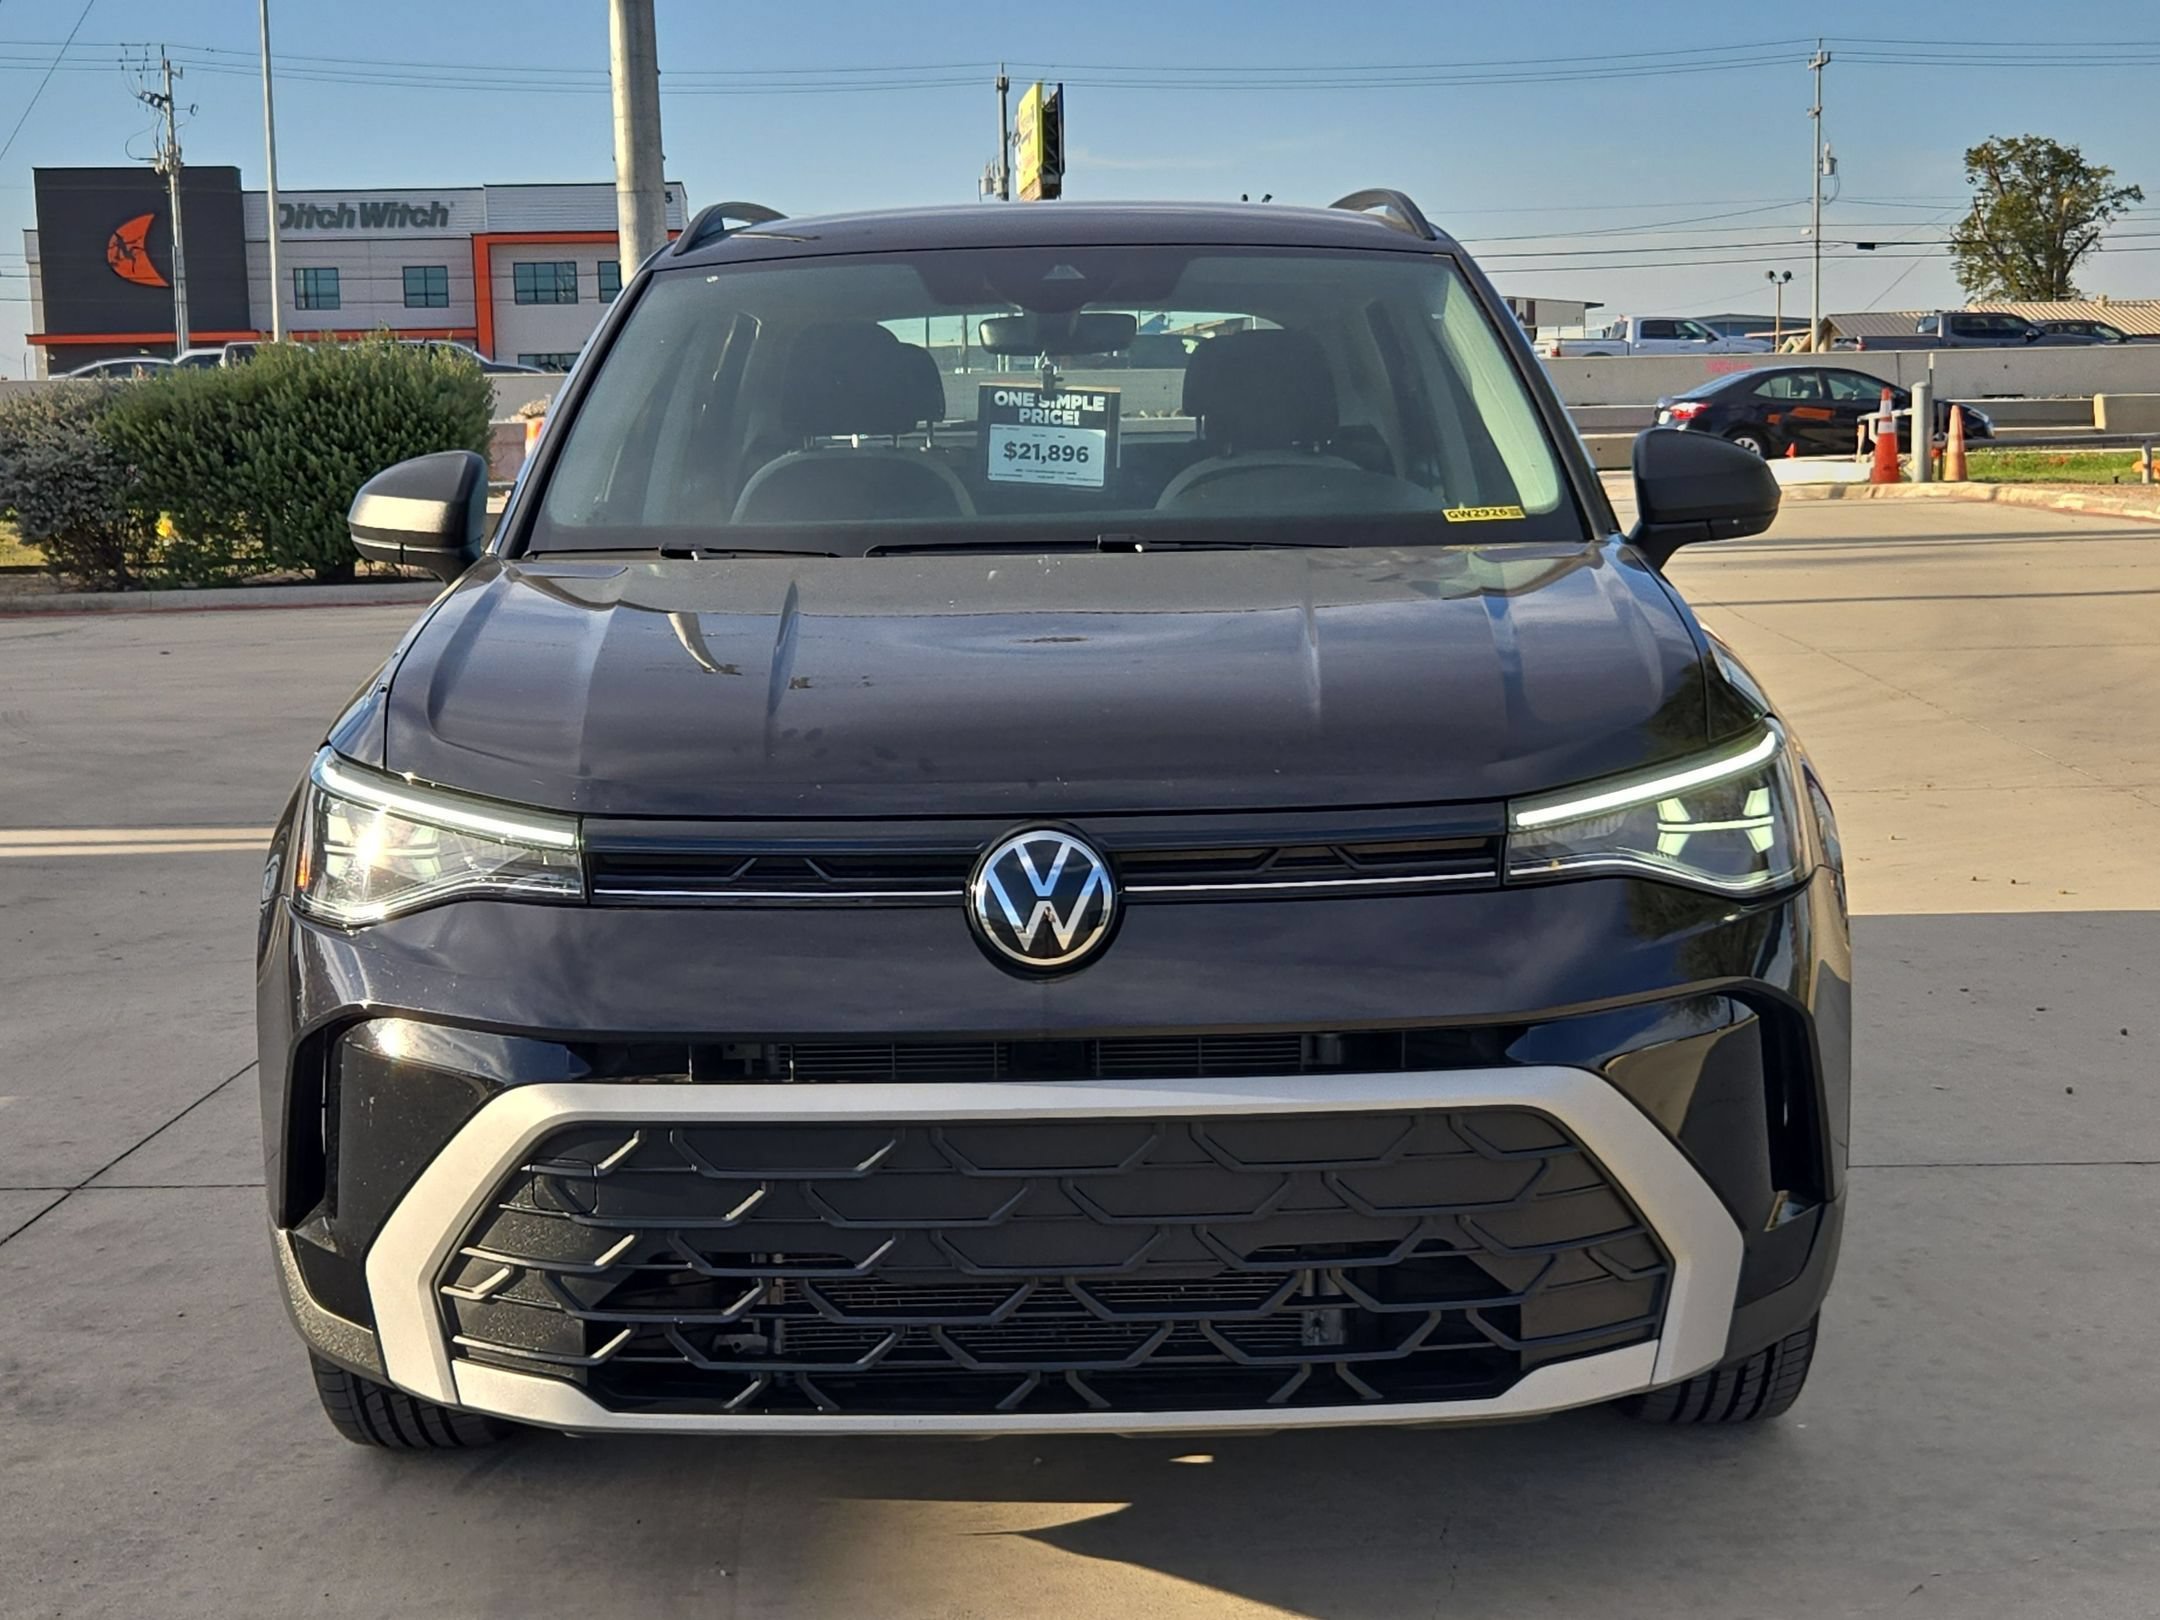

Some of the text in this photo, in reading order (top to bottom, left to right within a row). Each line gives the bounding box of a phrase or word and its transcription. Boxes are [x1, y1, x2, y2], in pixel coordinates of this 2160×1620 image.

[279, 202, 449, 230] Ditch Witch
[994, 391, 1105, 412] ONE SIMPLE
[1019, 408, 1080, 426] PRICE!
[1003, 441, 1089, 464] $21,896
